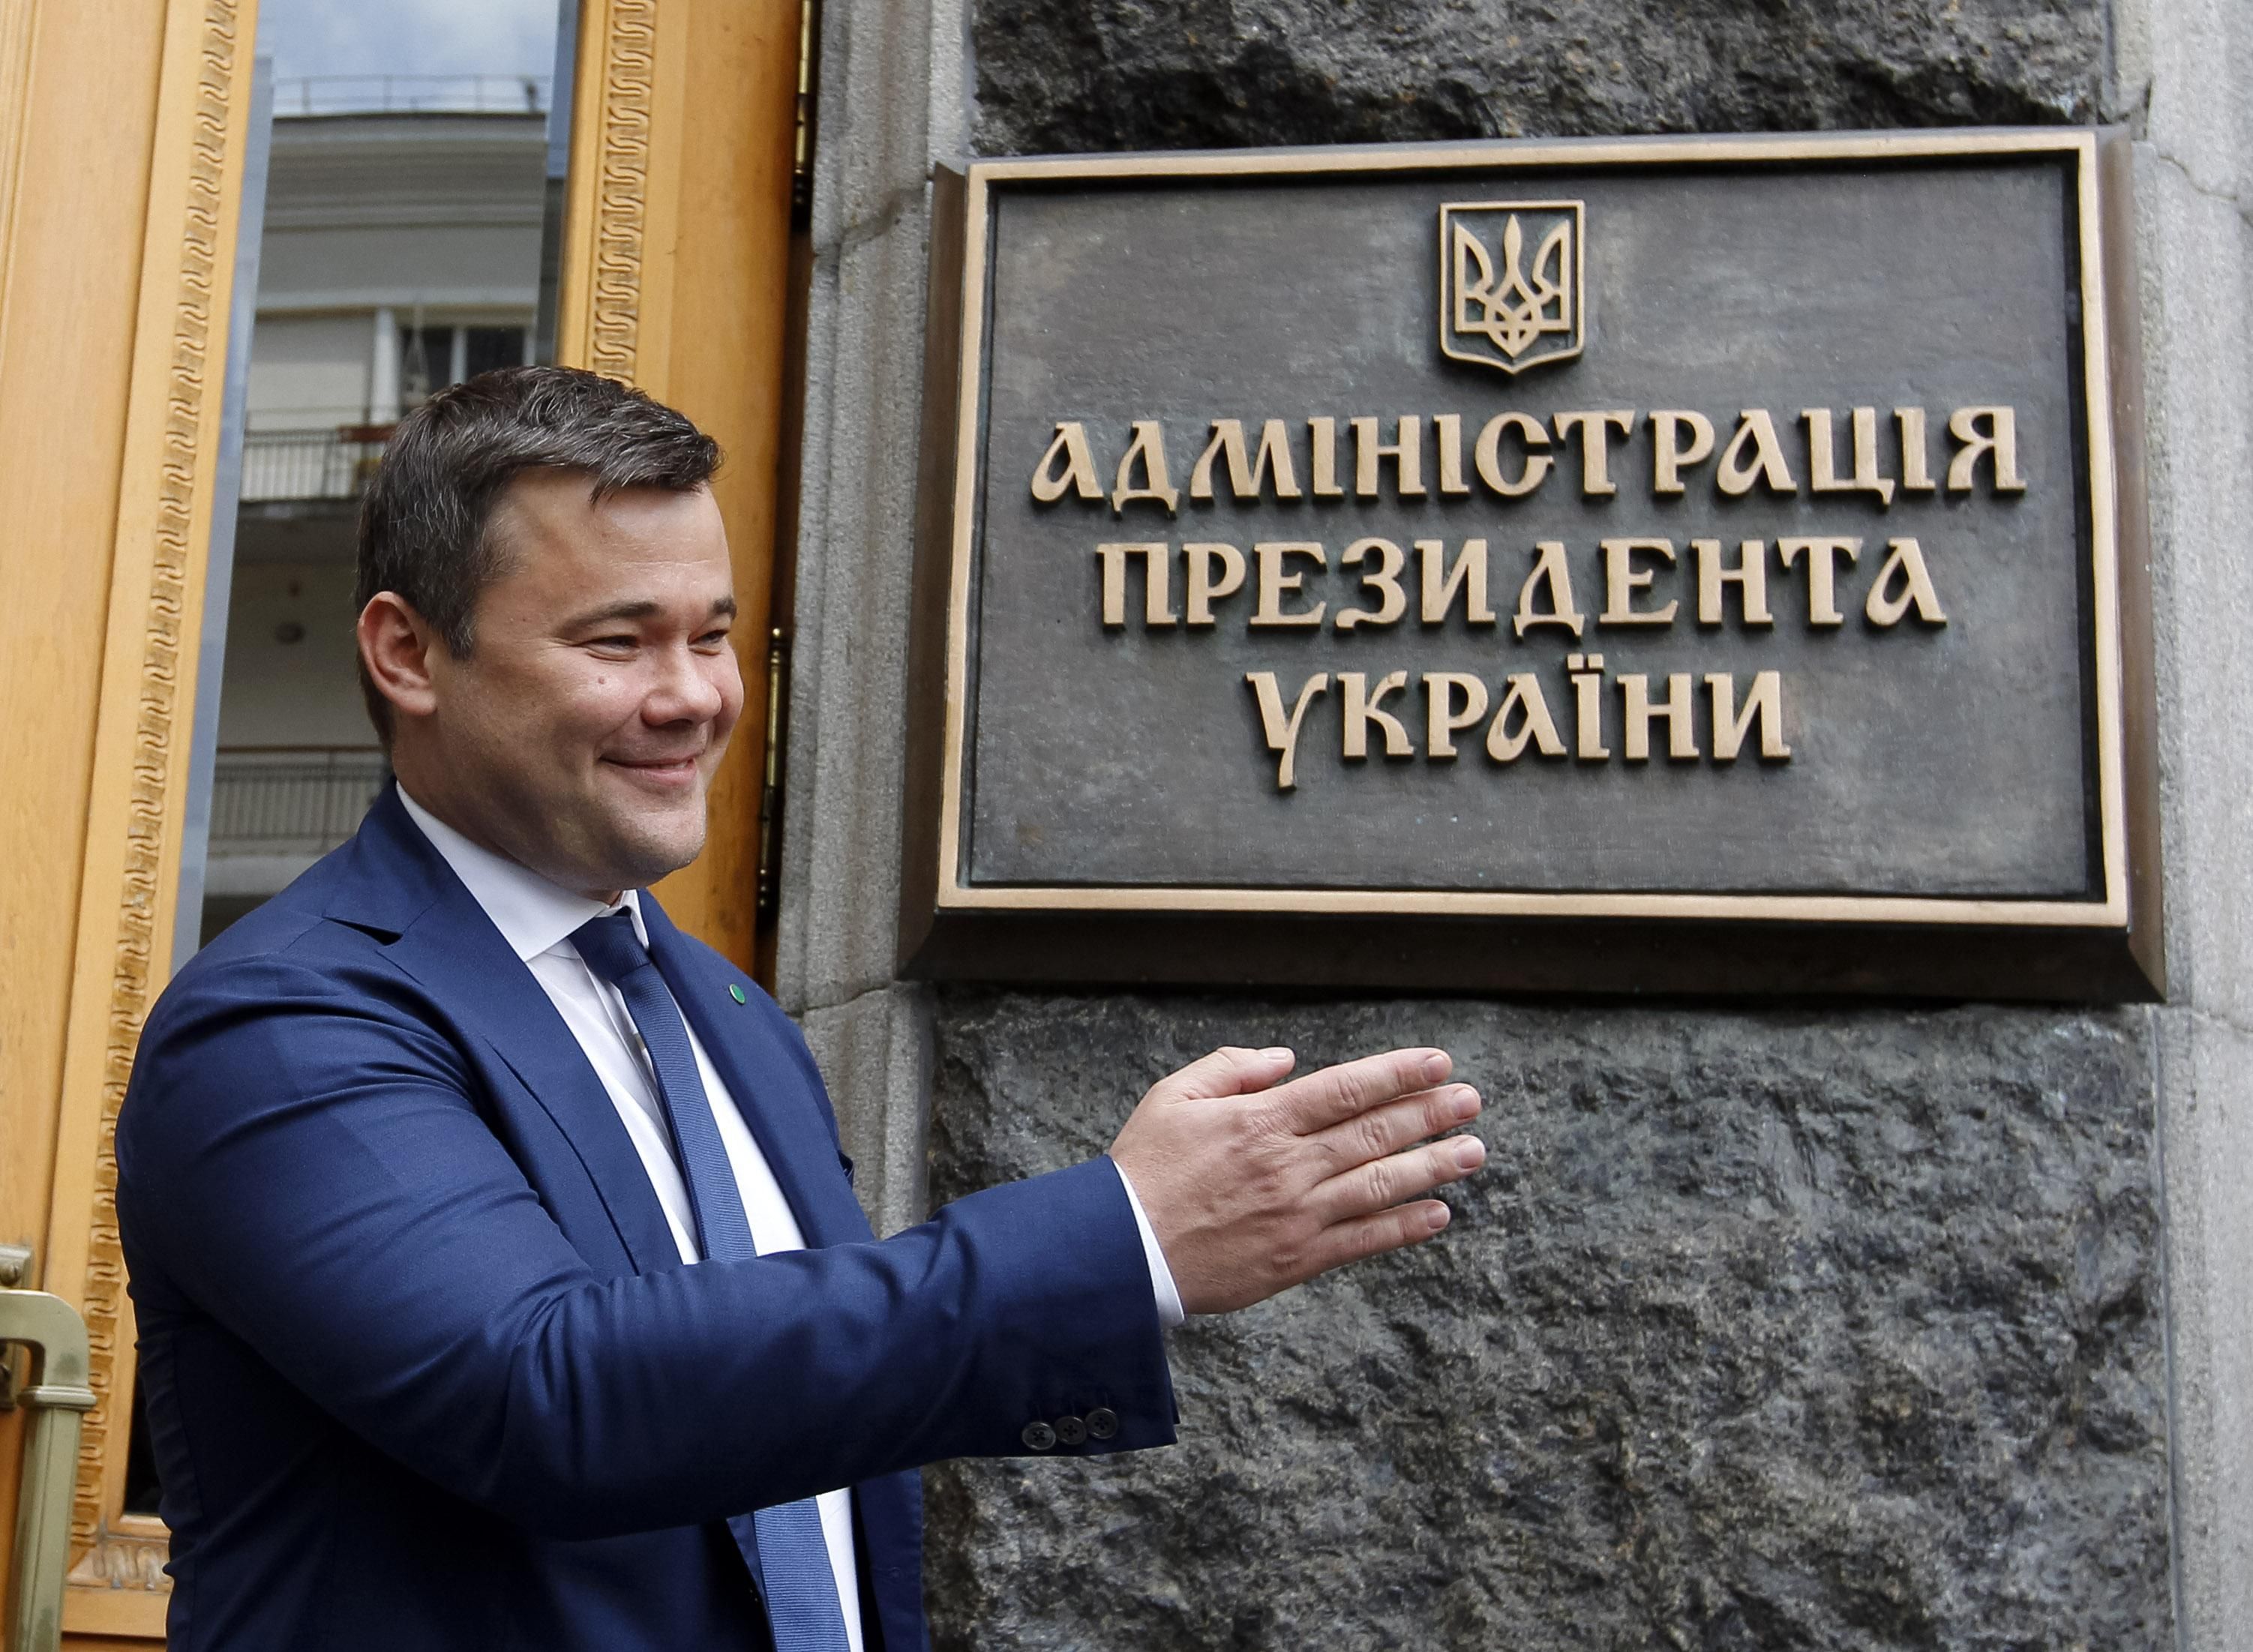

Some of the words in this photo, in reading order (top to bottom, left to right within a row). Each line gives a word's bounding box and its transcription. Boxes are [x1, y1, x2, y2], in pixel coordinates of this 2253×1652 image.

[1030, 406, 2027, 511] АДМІНІСТРАЦІЯ
[1096, 536, 1948, 637] ПРЕЗИДЕНТА
[1245, 653, 1792, 790] УКРАЇНИ
